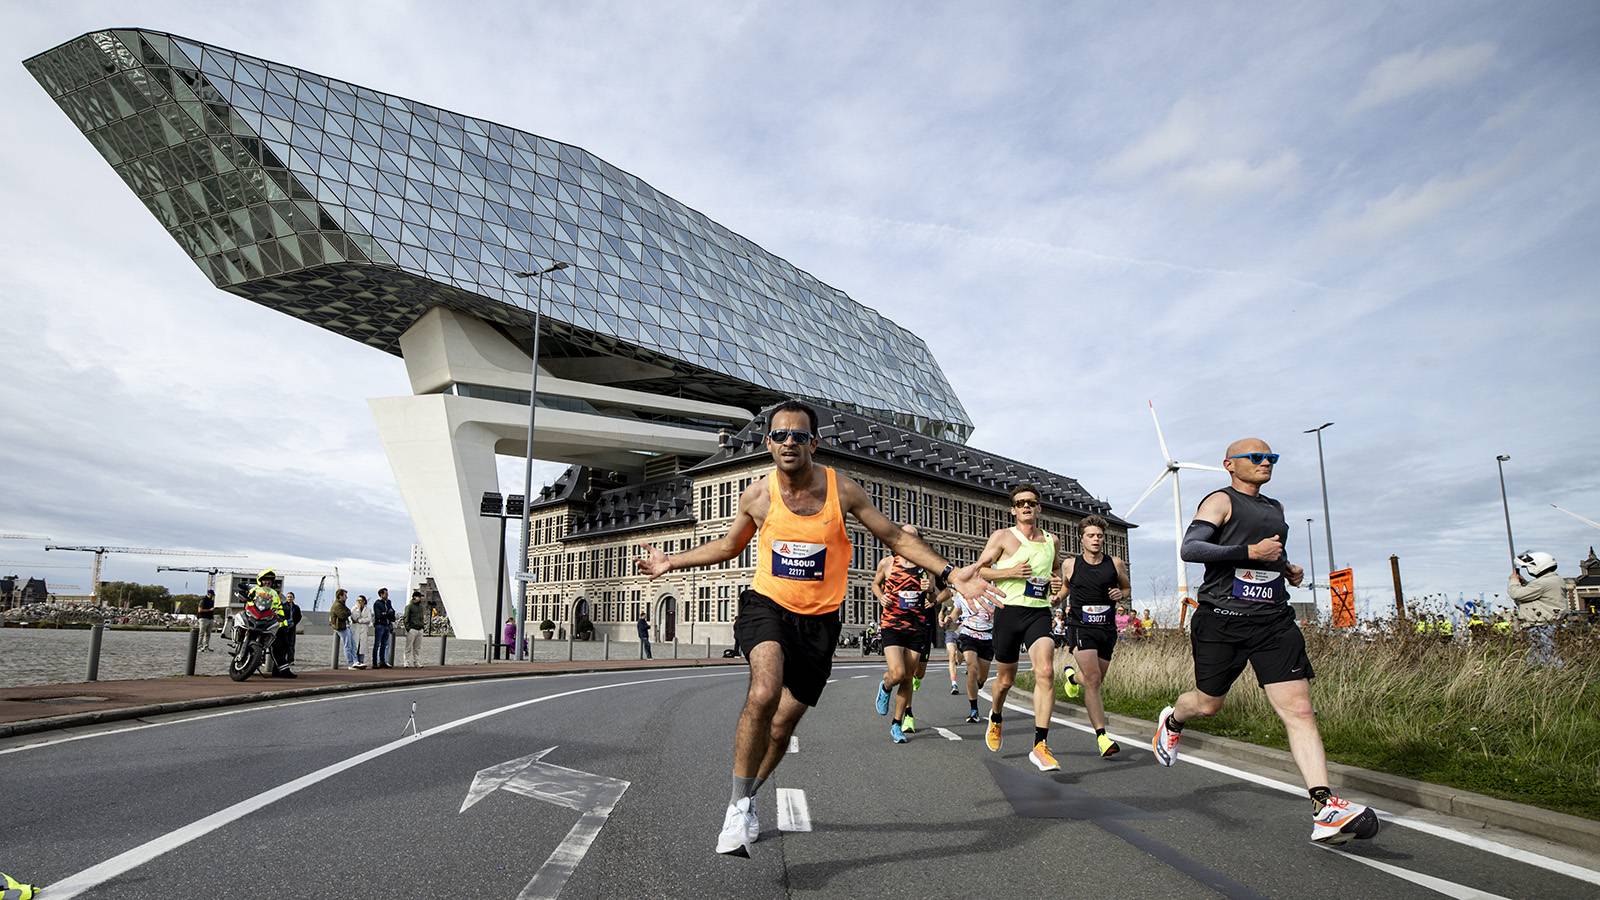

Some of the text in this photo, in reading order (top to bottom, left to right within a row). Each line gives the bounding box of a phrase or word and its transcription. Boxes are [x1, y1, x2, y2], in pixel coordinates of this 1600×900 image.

[781, 557, 815, 567] MASOUD
[788, 567, 805, 576] 22171
[1242, 585, 1273, 599] 34760
[1088, 614, 1106, 623] 33071
